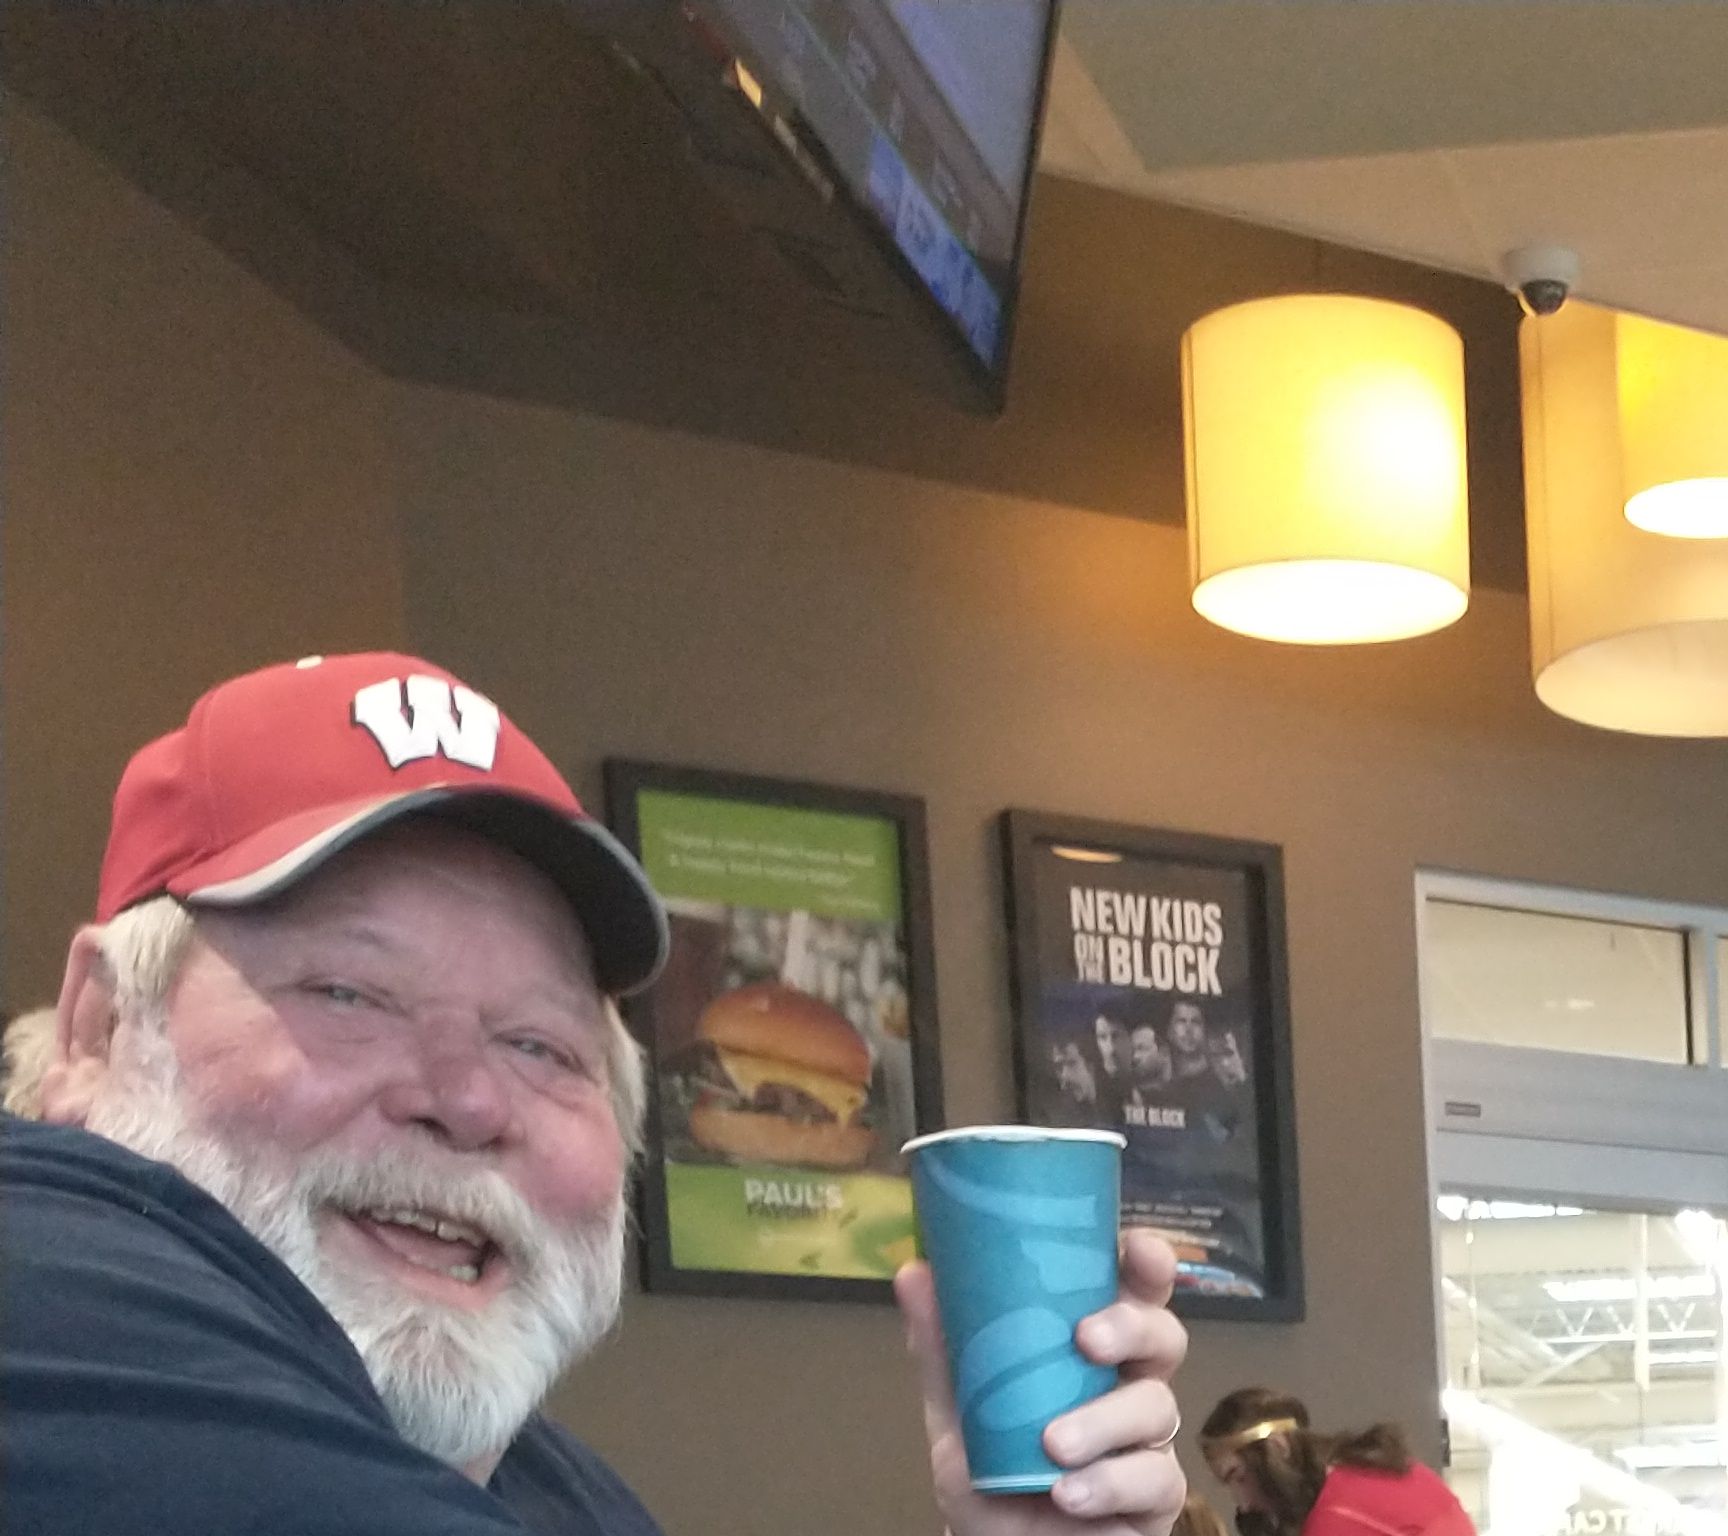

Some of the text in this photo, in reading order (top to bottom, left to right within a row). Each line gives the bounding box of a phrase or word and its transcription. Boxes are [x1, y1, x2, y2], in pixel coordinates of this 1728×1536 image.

[354, 674, 499, 771] W
[1070, 886, 1223, 946] NEW KIDS
[1108, 936, 1223, 995] BLOCK
